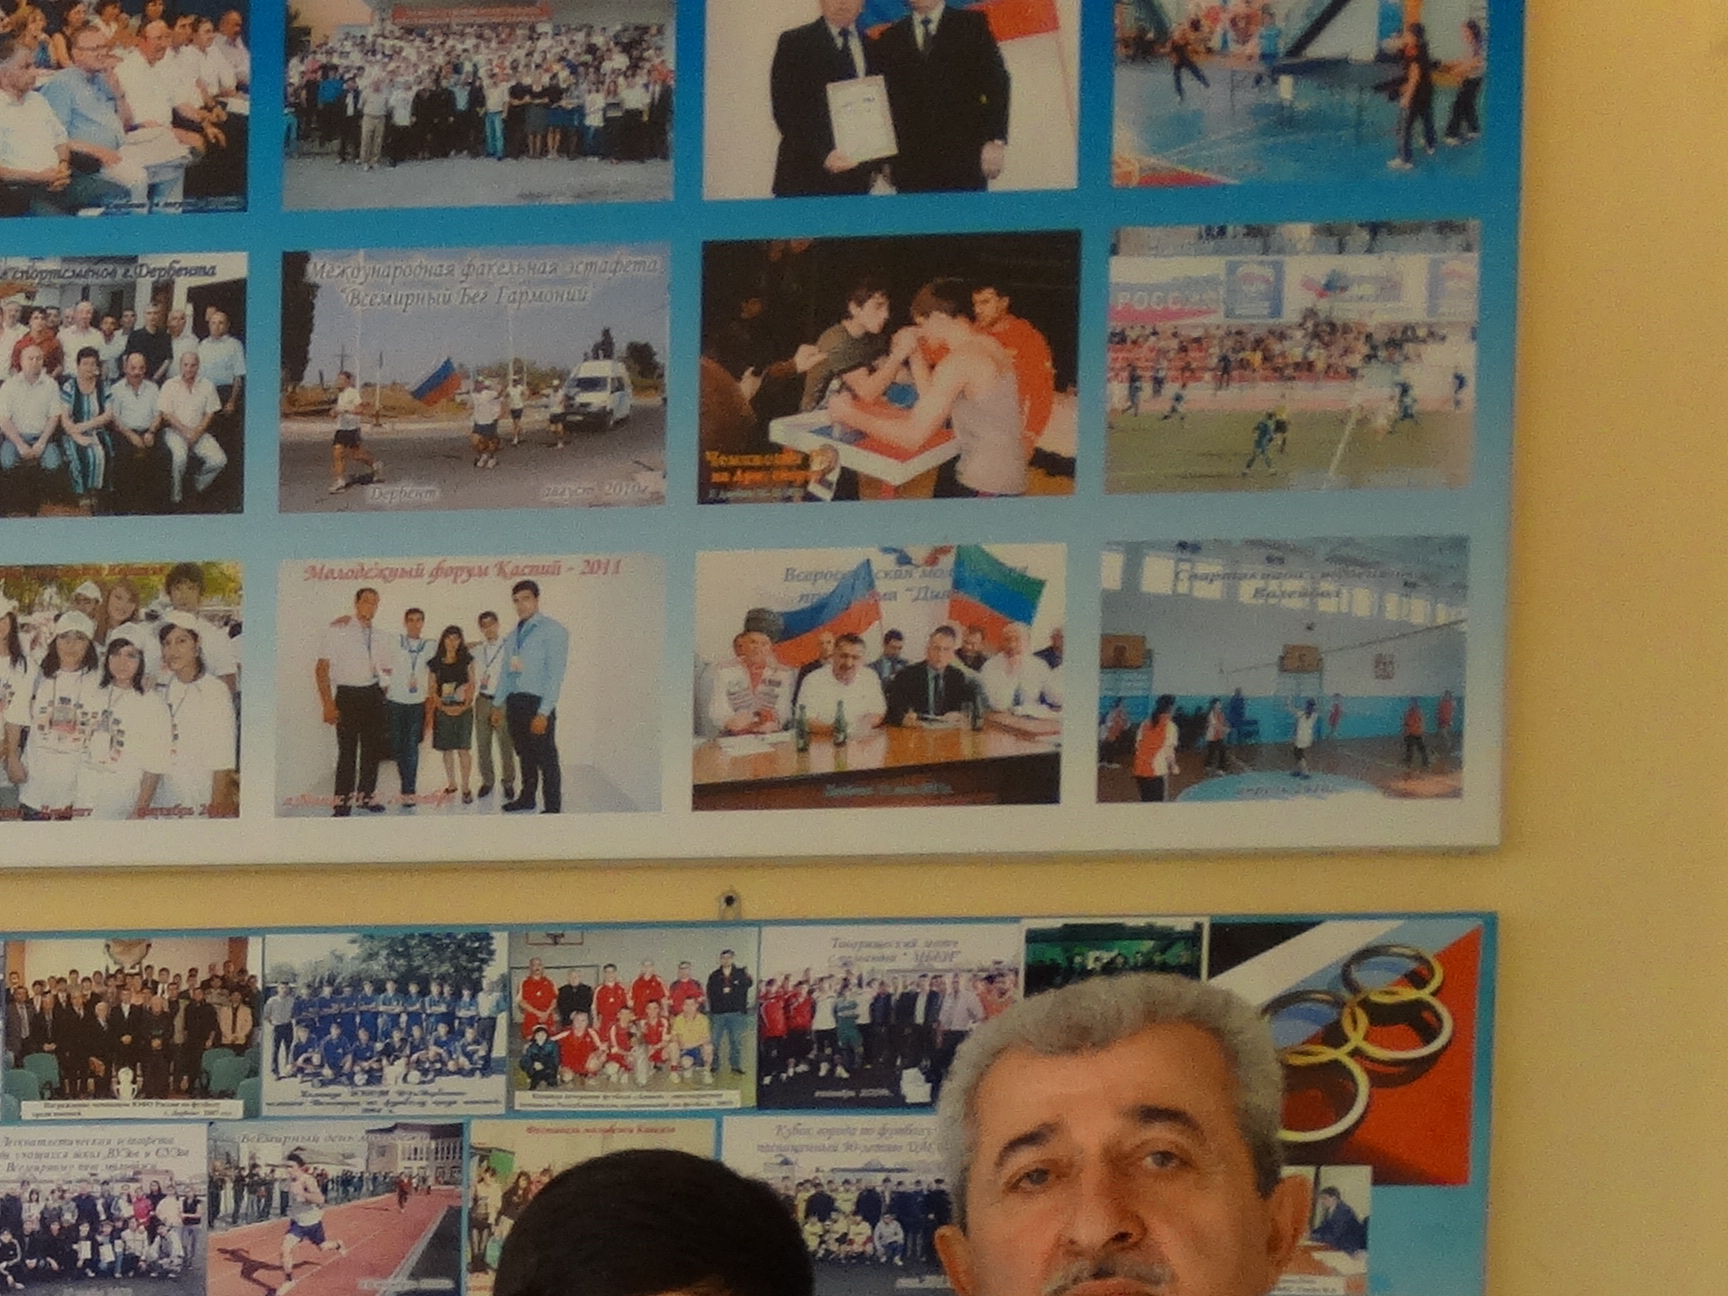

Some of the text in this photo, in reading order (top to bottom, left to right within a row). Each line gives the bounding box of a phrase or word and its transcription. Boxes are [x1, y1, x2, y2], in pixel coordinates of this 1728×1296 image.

[304, 562, 426, 583] Молодежный
[427, 561, 490, 584] форум
[496, 559, 562, 577] Каспий
